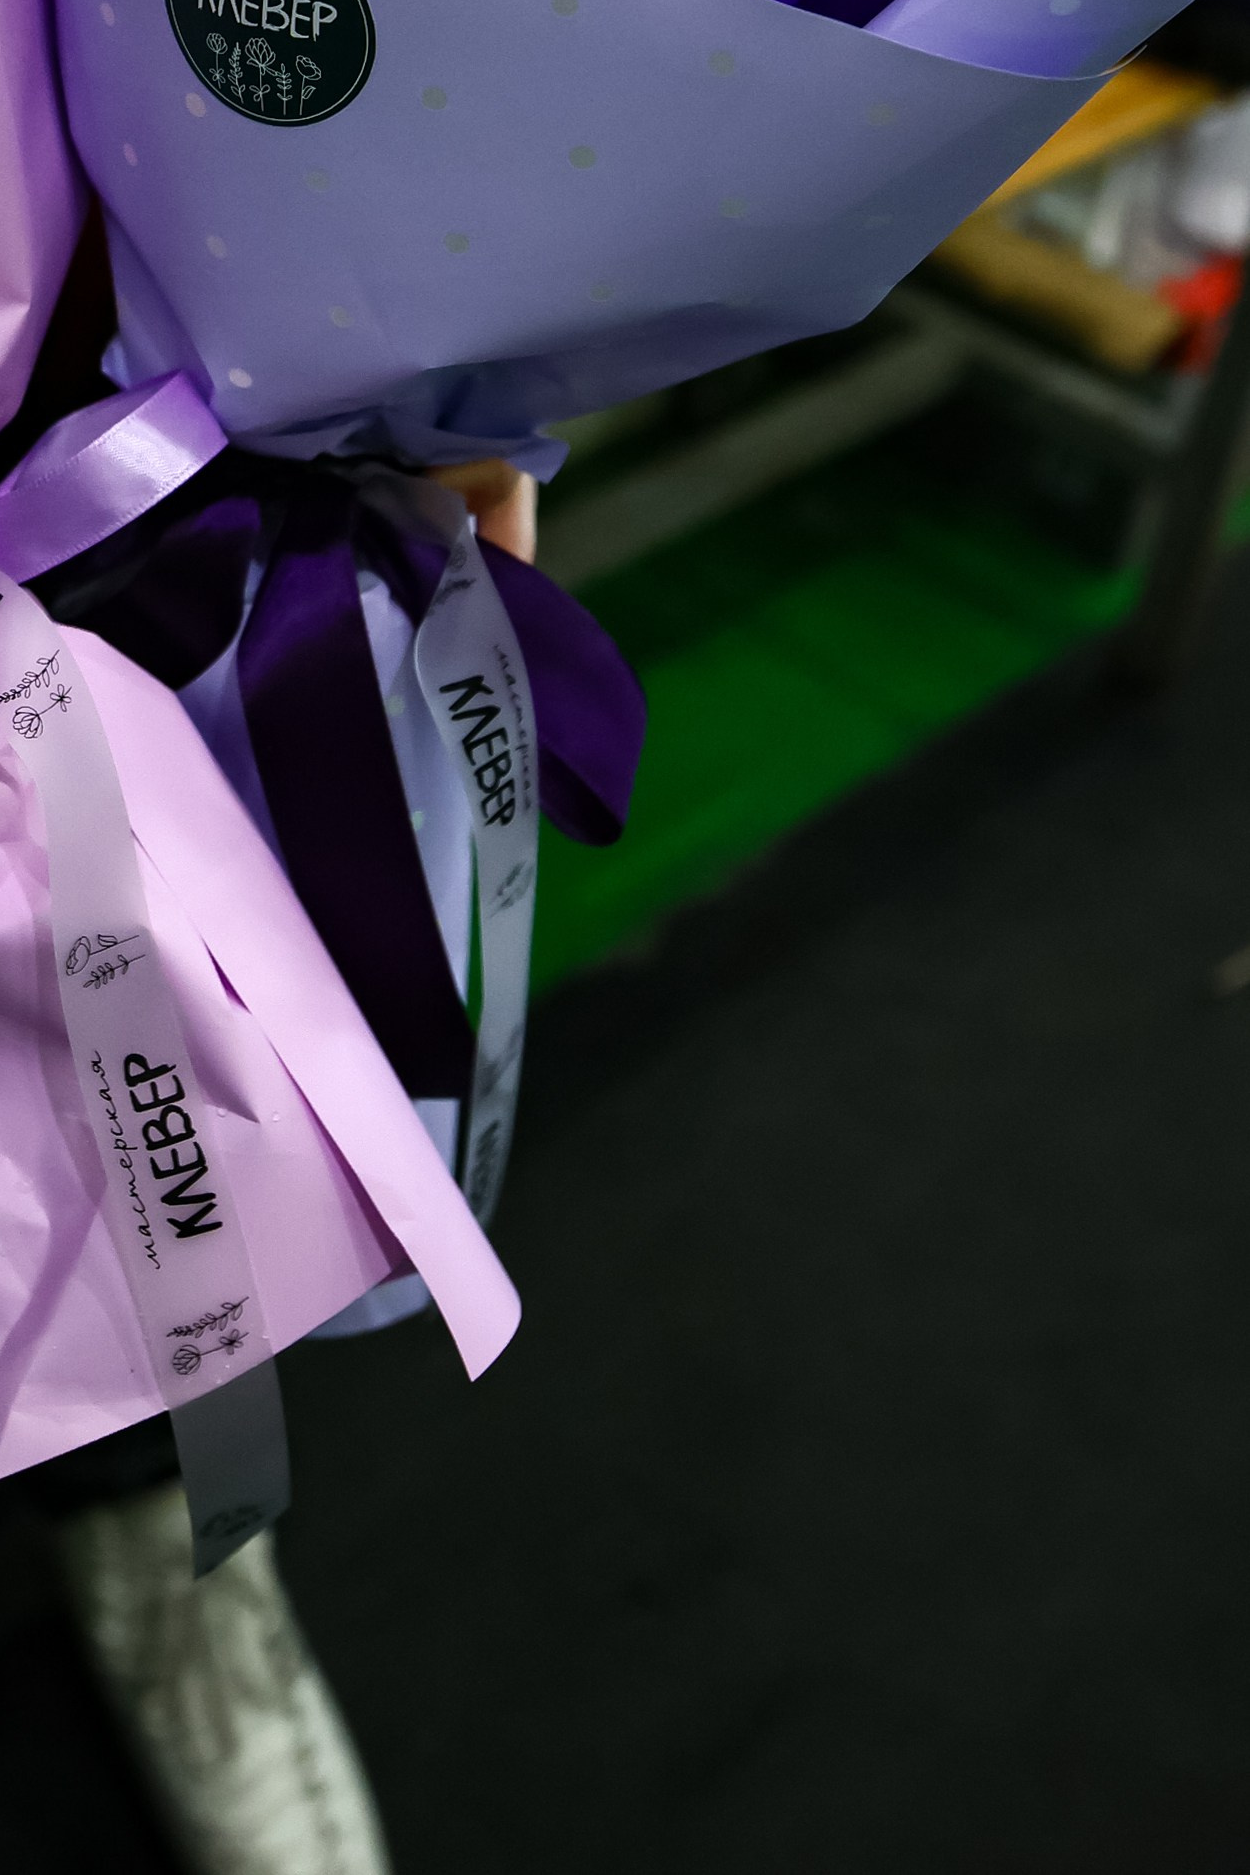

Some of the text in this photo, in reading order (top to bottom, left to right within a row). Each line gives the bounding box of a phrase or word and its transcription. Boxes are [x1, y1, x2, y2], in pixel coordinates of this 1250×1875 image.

[439, 675, 516, 826] КЛЕВЕР
[90, 1050, 161, 1269] мастерская
[123, 1053, 223, 1239] КЛЕВЕР
